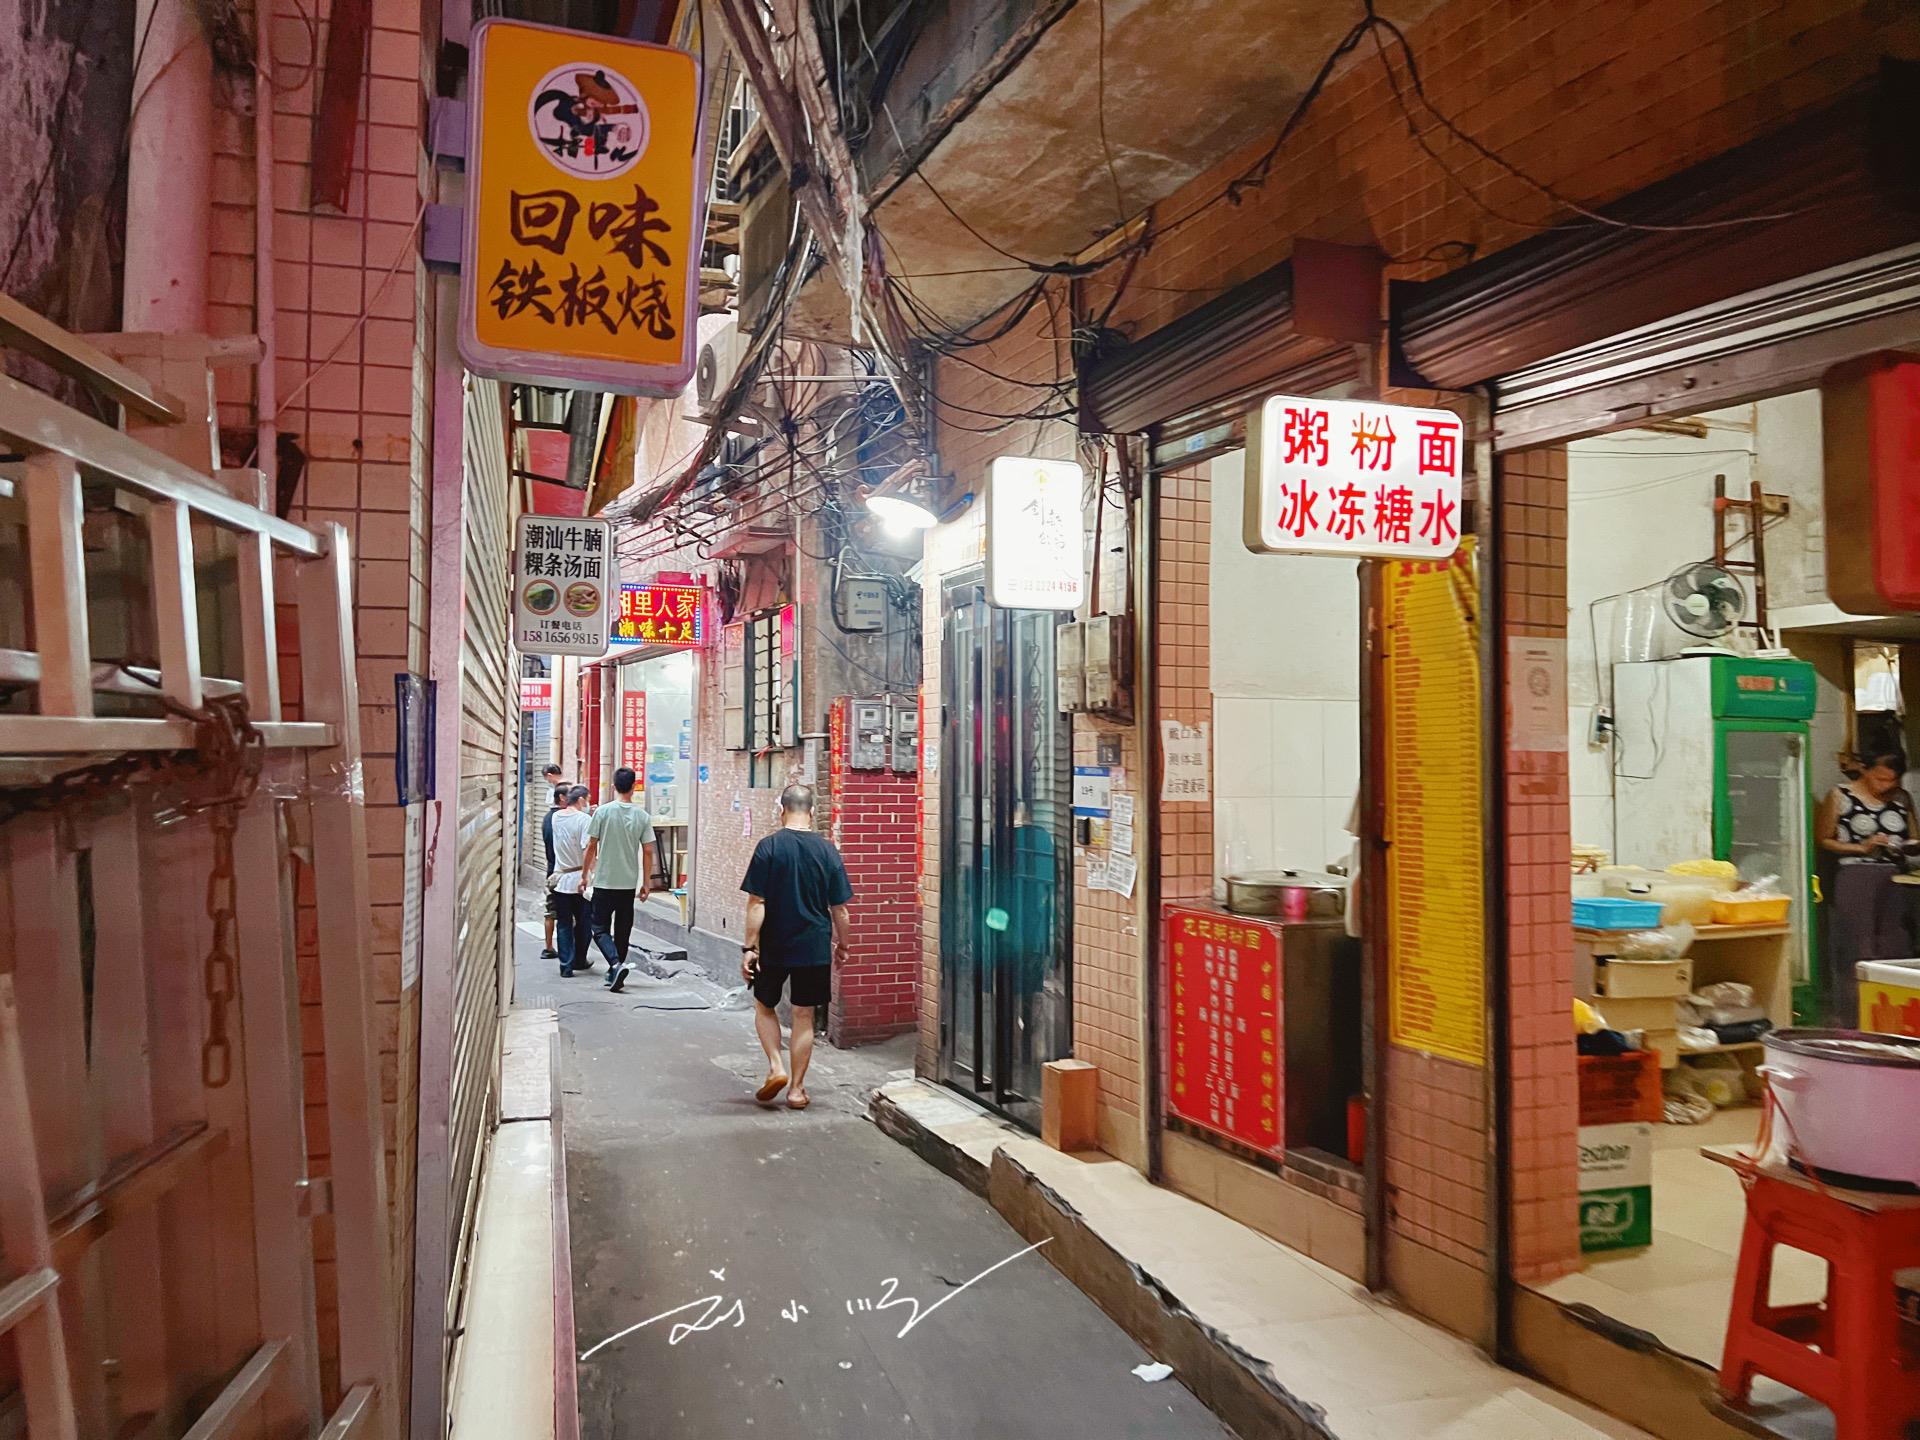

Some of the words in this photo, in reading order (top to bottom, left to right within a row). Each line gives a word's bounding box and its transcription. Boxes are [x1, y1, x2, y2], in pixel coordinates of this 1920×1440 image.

[510, 184, 672, 269] 回味
[488, 258, 675, 340] 铁板烧
[1284, 408, 1459, 477] 粥粉面
[525, 524, 603, 552] 潮汕牛腩
[1278, 479, 1457, 545] 冰冻糖水
[525, 551, 601, 579] 粿条汤面
[523, 630, 542, 643] 158
[545, 631, 570, 644] 1656
[572, 632, 599, 645] 9815
